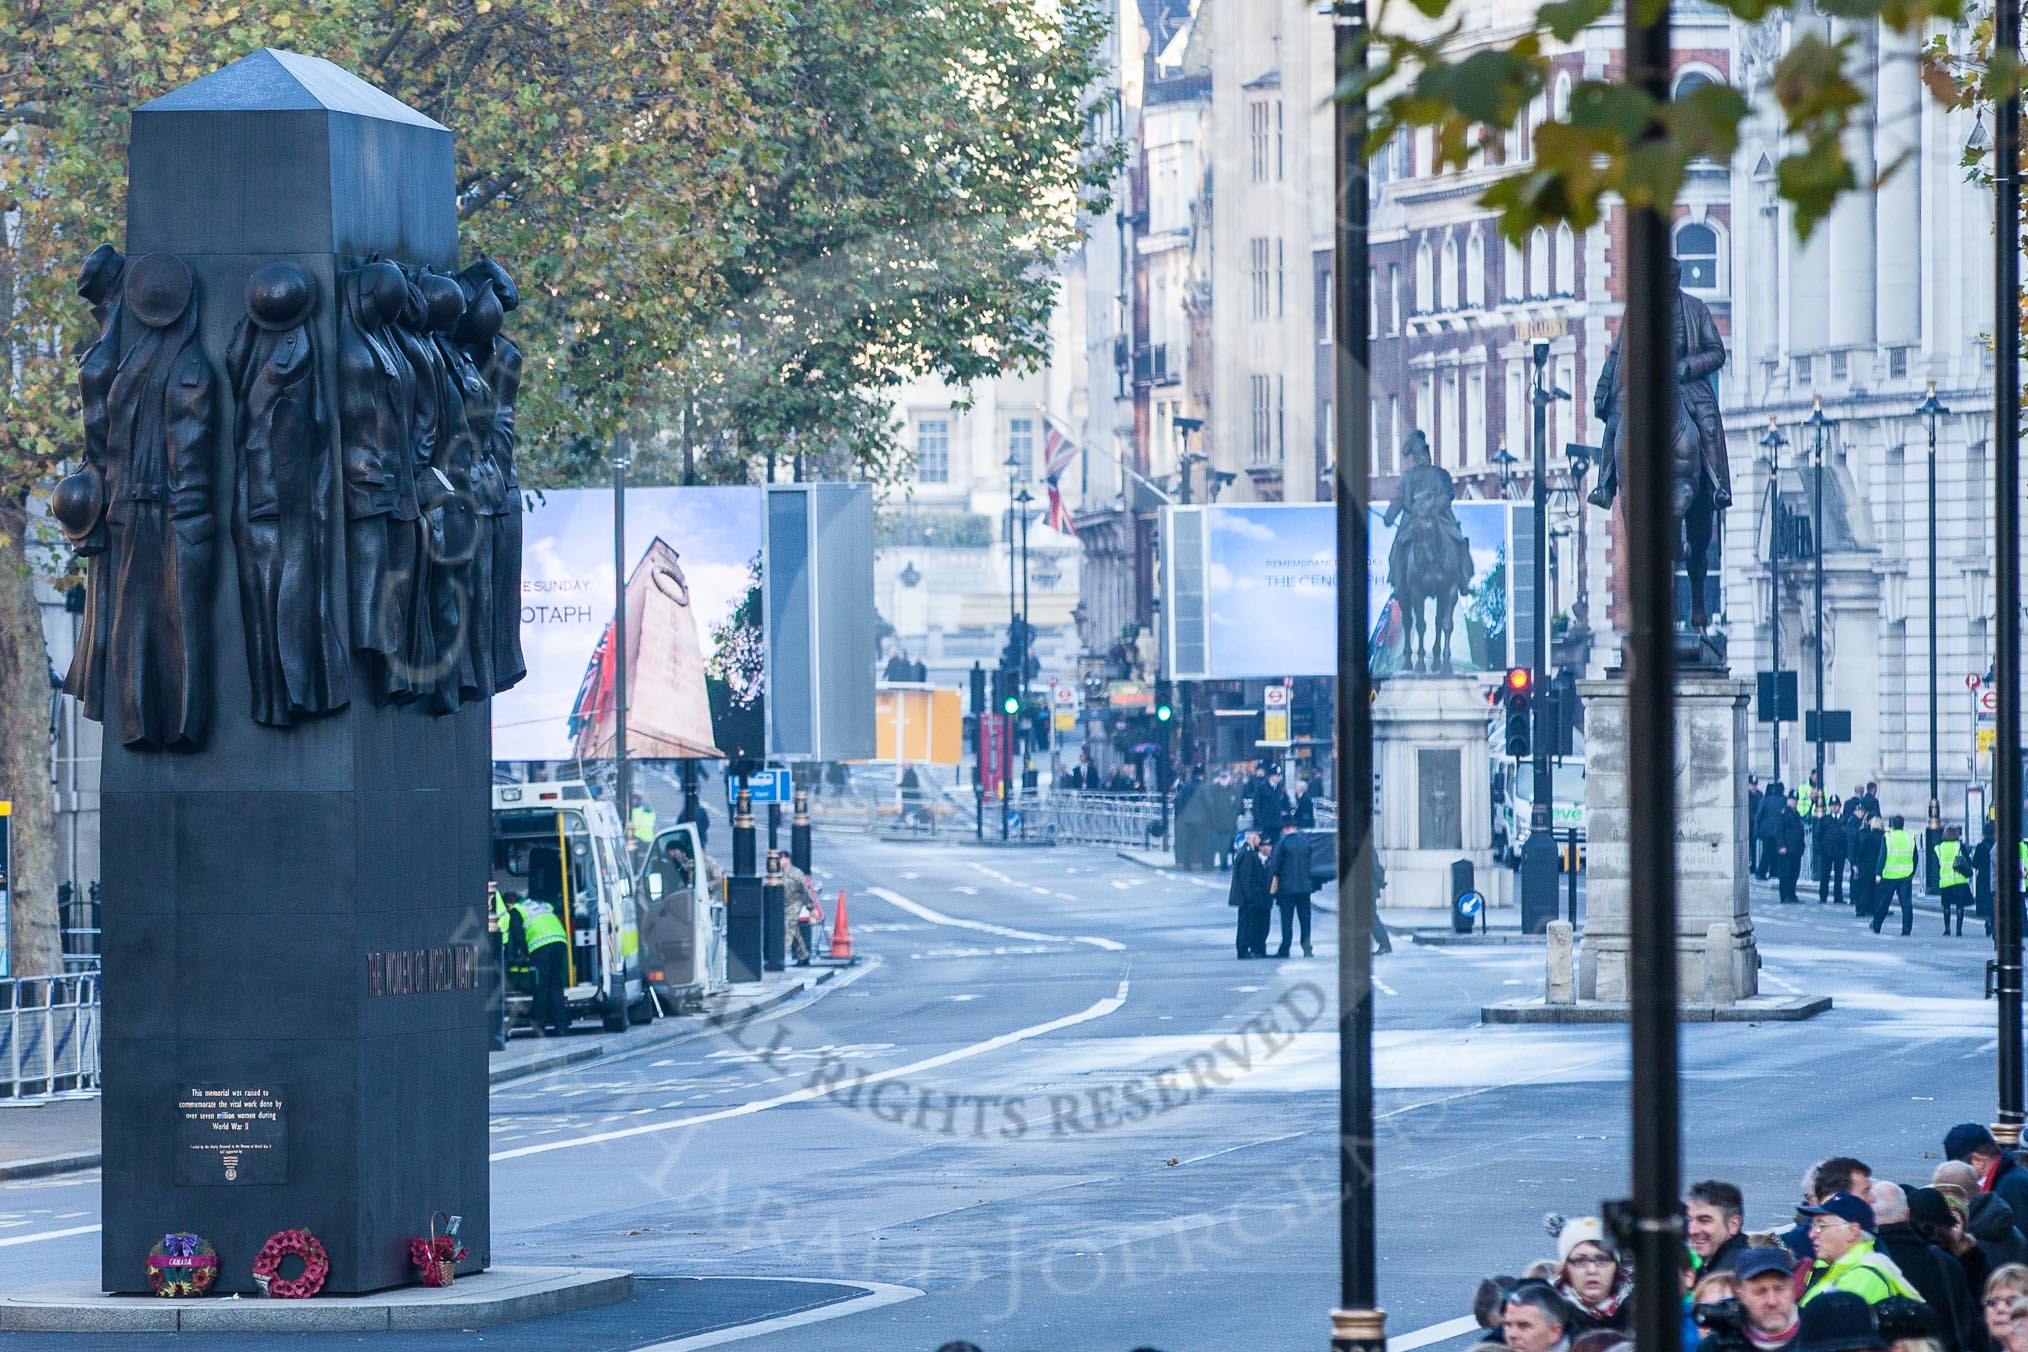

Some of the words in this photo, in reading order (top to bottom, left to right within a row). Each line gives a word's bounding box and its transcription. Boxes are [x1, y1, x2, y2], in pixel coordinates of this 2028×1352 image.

[1265, 575, 1296, 588] THE
[384, 950, 413, 997] WOMEN
[428, 946, 453, 993] WORLD
[455, 945, 471, 990] WAR
[191, 1088, 203, 1097] This
[204, 1088, 230, 1097] memorial
[244, 1088, 261, 1097] raised
[263, 1089, 269, 1097] to
[178, 1101, 217, 1109] commemorate
[219, 1100, 227, 1109] the
[229, 1100, 242, 1109] vital
[243, 1100, 257, 1109] work
[259, 1100, 273, 1109] done
[275, 1100, 283, 1110] by
[185, 1112, 198, 1120] over
[199, 1112, 215, 1120] seven
[216, 1111, 235, 1120] million
[236, 1112, 256, 1120] women
[258, 1111, 277, 1121] during
[212, 1122, 230, 1131] World
[231, 1122, 243, 1131] War
[168, 1258, 192, 1267] CANADA
